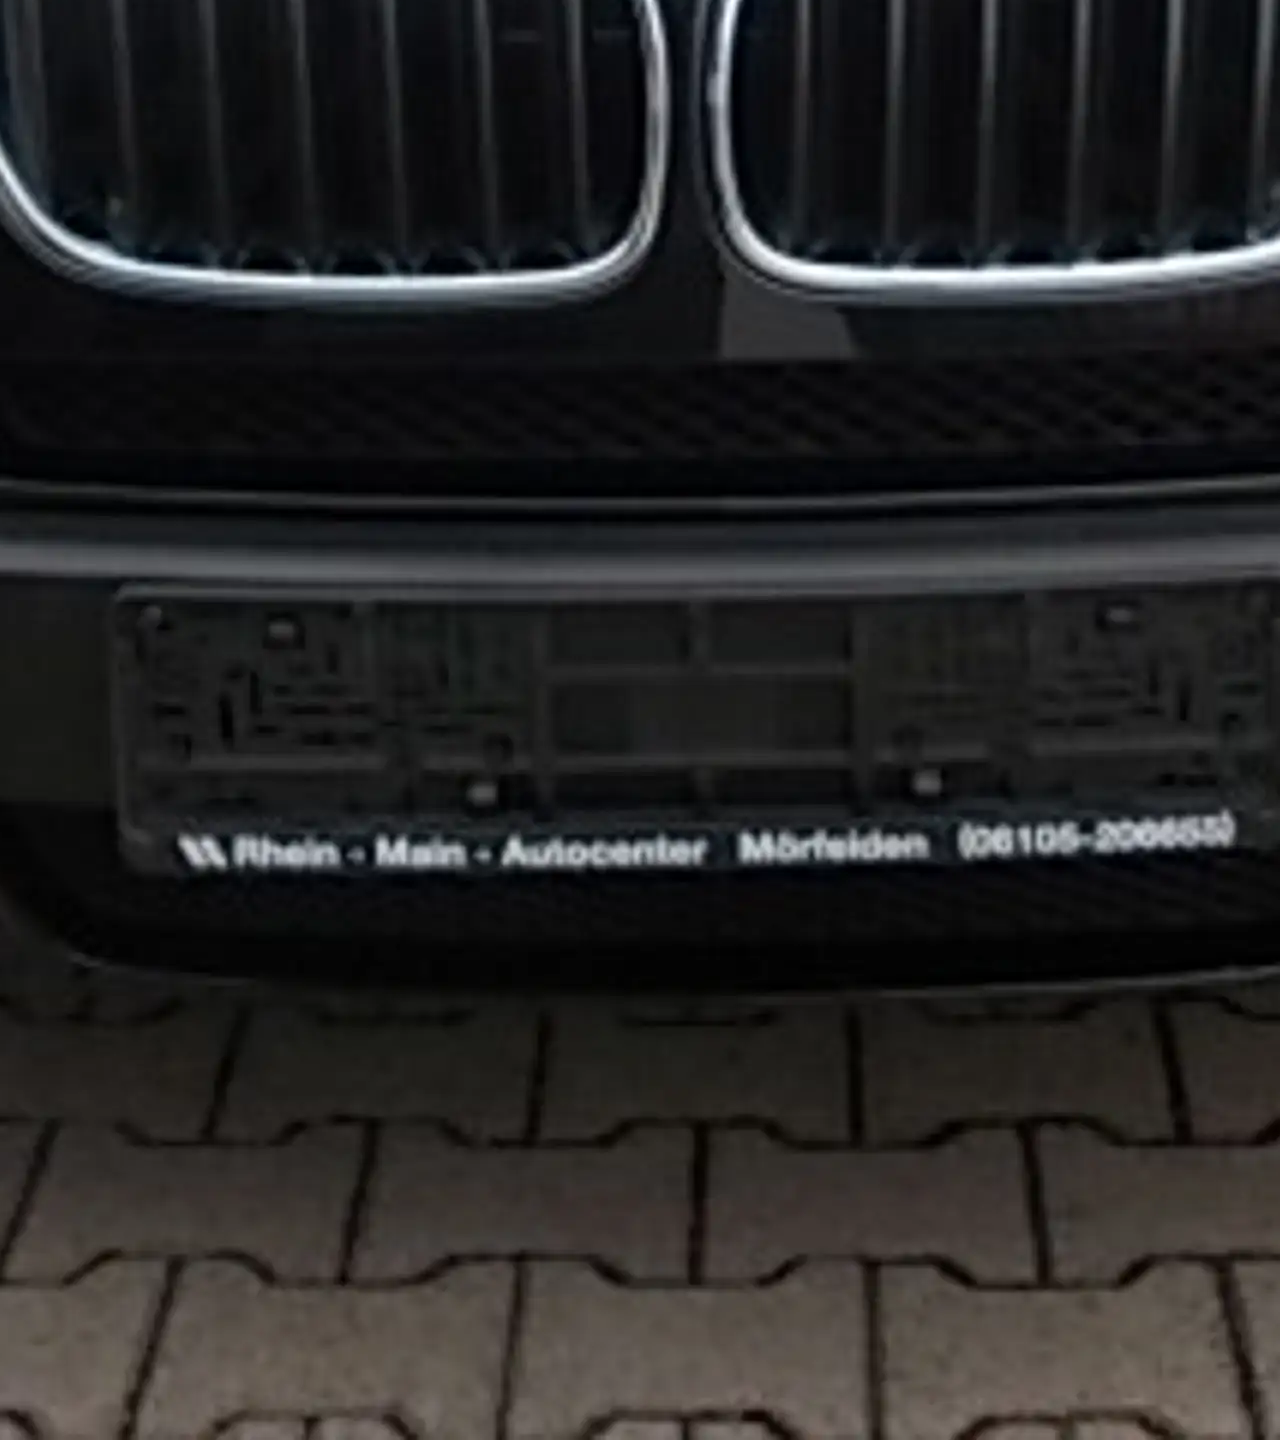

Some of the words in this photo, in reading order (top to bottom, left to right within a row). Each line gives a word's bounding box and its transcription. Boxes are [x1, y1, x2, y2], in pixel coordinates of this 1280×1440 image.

[230, 833, 341, 868] Rhein
[374, 832, 468, 868] Main
[499, 832, 710, 868] Autocenter
